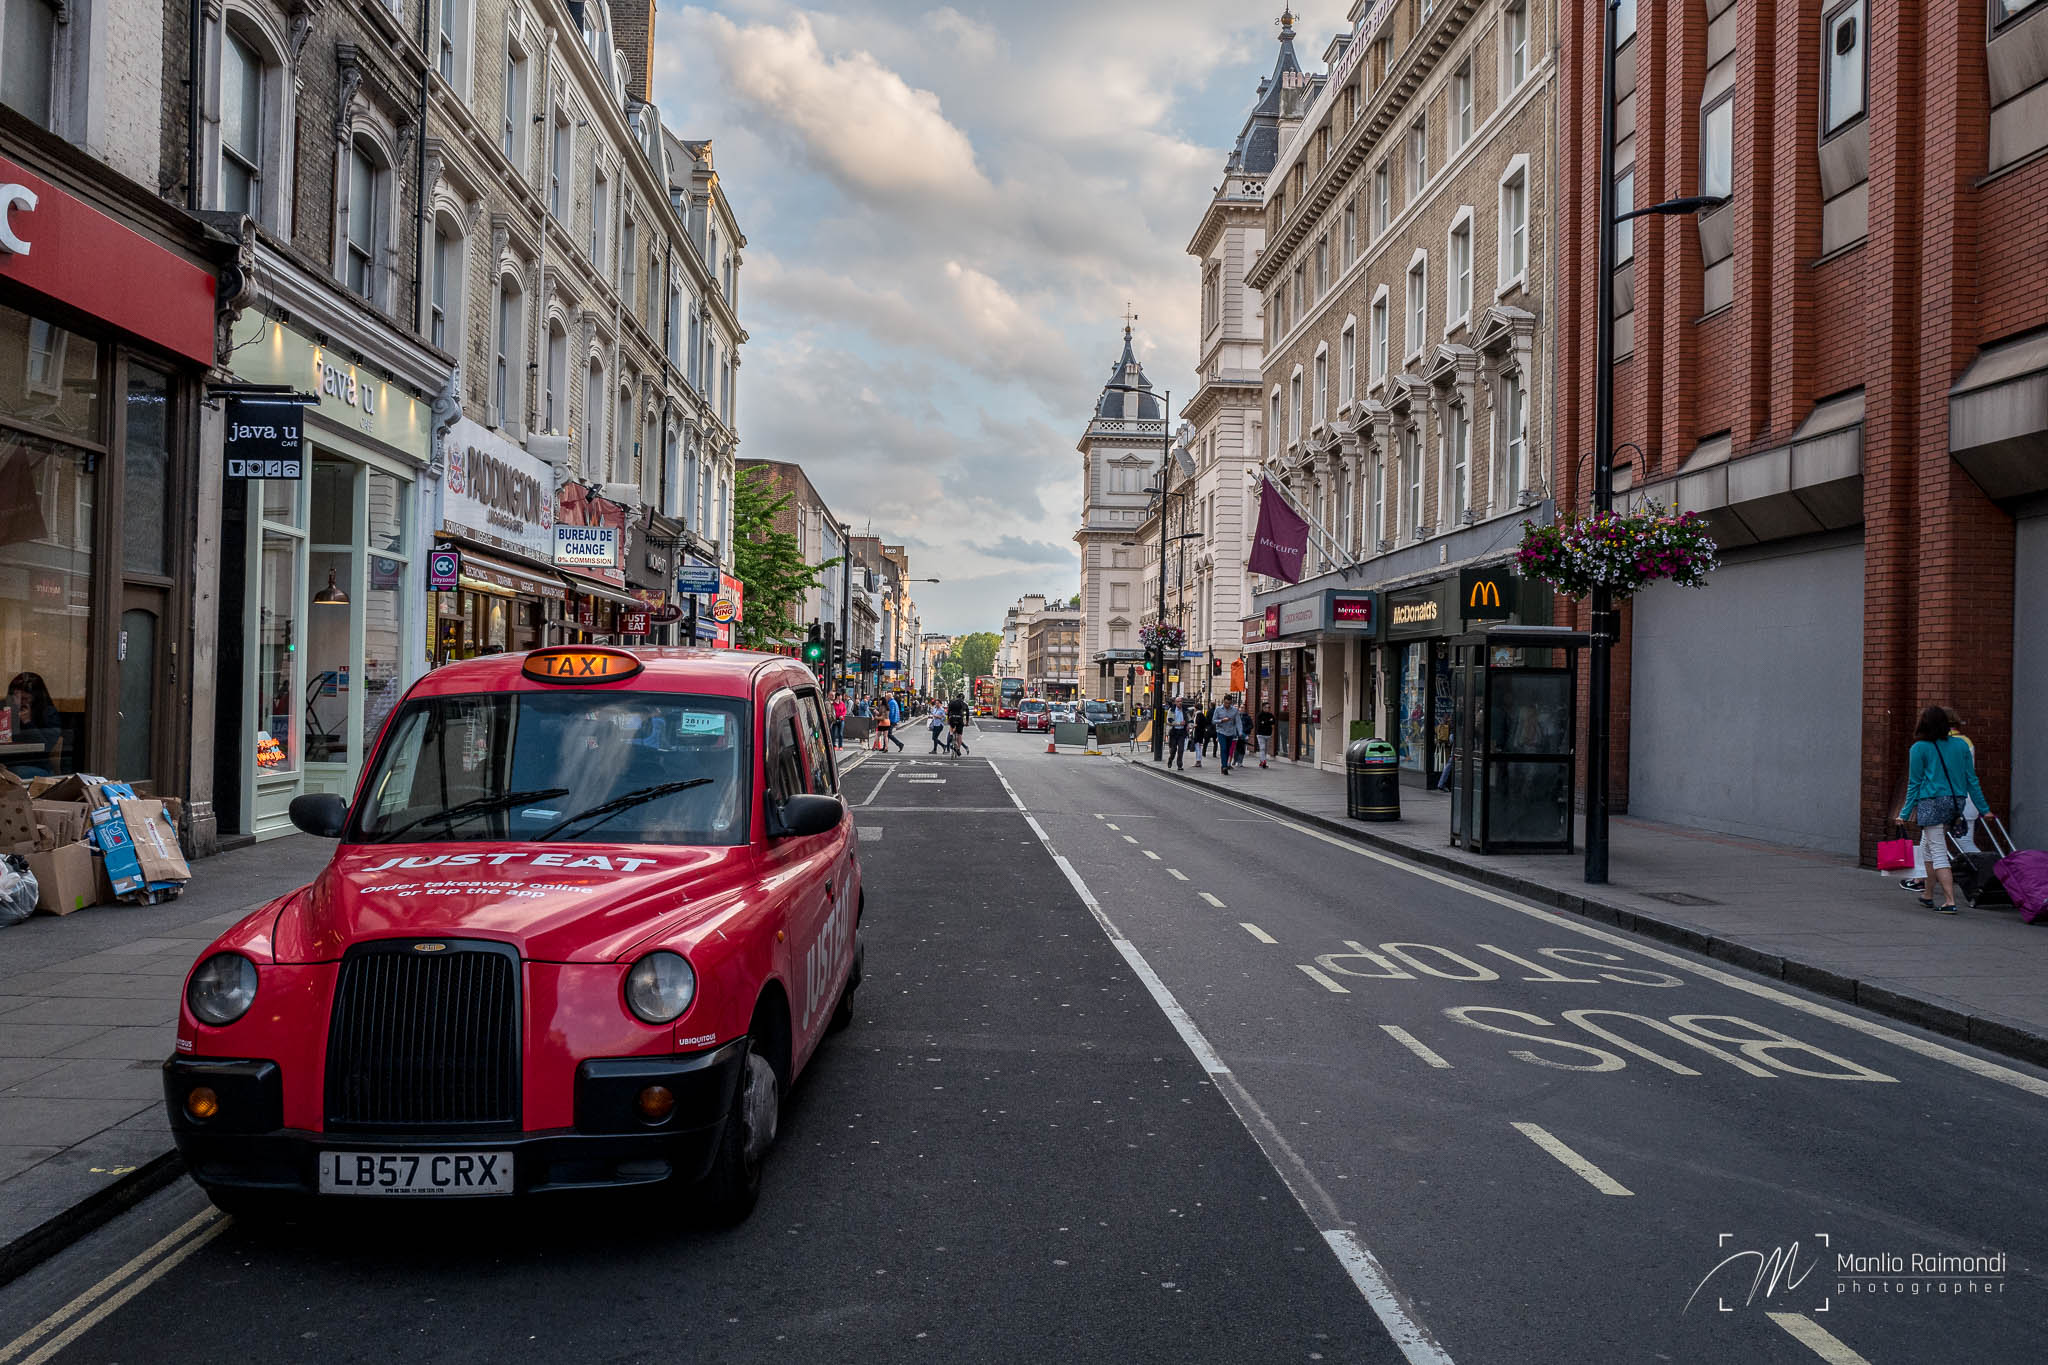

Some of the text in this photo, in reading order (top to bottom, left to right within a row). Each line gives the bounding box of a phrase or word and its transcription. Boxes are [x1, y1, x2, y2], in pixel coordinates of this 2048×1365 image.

[315, 352, 374, 415] java u
[229, 422, 298, 442] java u
[467, 445, 541, 525] PADDINGTON
[559, 528, 612, 541] BUREAU DE
[566, 543, 605, 555] CHANGE
[1260, 537, 1299, 555] Mercure
[713, 604, 732, 612] BURGER
[714, 609, 733, 617] KING
[1393, 600, 1437, 624] McDonald's
[623, 614, 646, 622] JUST
[628, 623, 646, 631] EAT
[544, 657, 608, 675] TAXI
[361, 853, 658, 872] JUST EAT
[360, 880, 593, 894] Order takeaway online
[397, 886, 546, 898] or tap the app
[802, 907, 835, 1031] JUST
[1314, 940, 1684, 988] STOP
[679, 1032, 716, 1046] UBIQUITOUS
[1440, 1006, 1901, 1082] BUS
[335, 1155, 498, 1187] LB57 CRX
